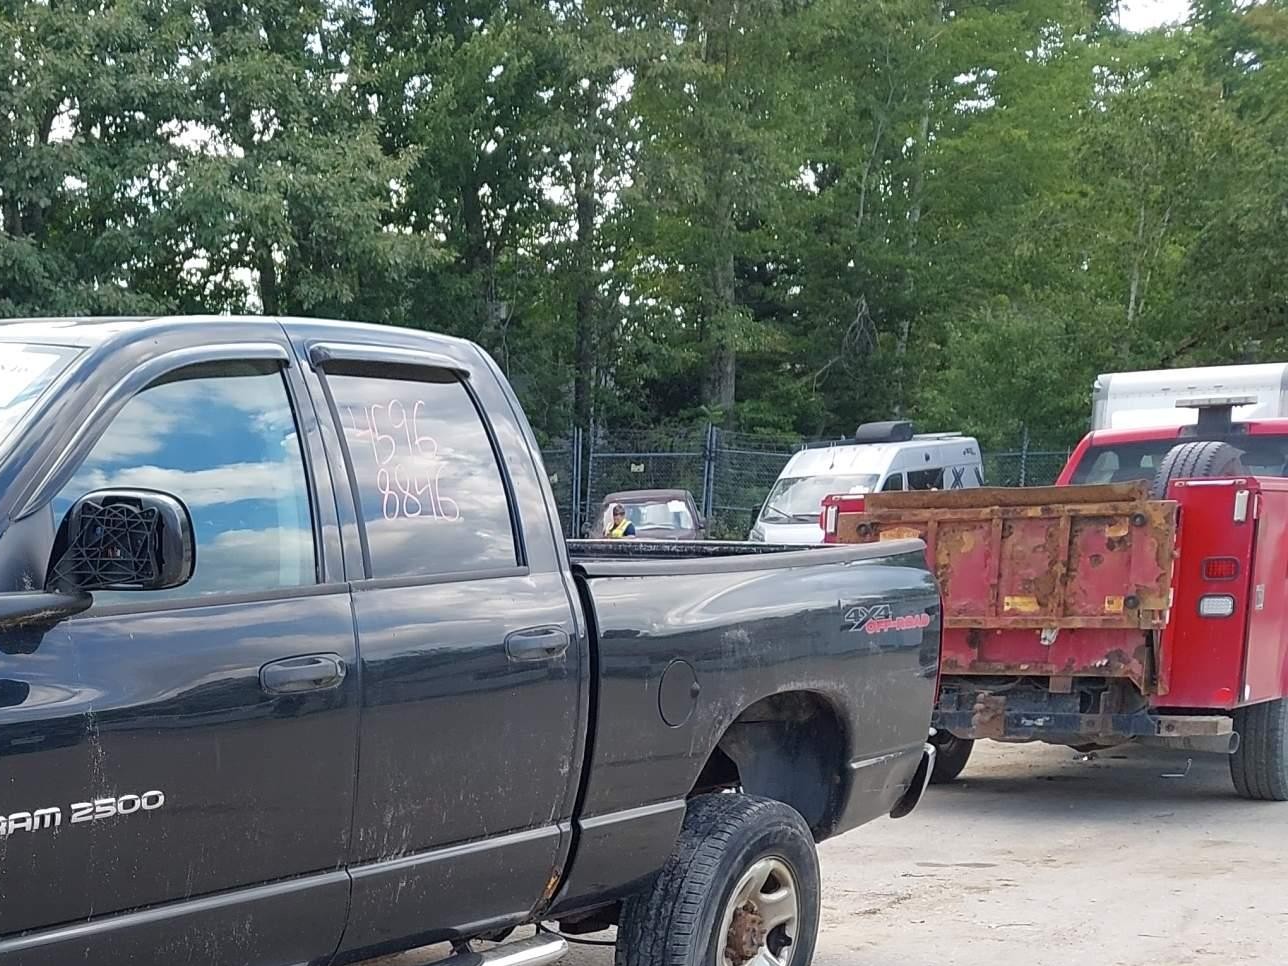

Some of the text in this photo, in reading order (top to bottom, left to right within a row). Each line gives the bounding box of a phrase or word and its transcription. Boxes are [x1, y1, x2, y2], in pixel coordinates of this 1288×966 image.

[347, 399, 438, 465] 4596
[376, 463, 464, 521] 8846
[865, 612, 930, 634] OFF-ROAD
[70, 790, 165, 824] 2500
